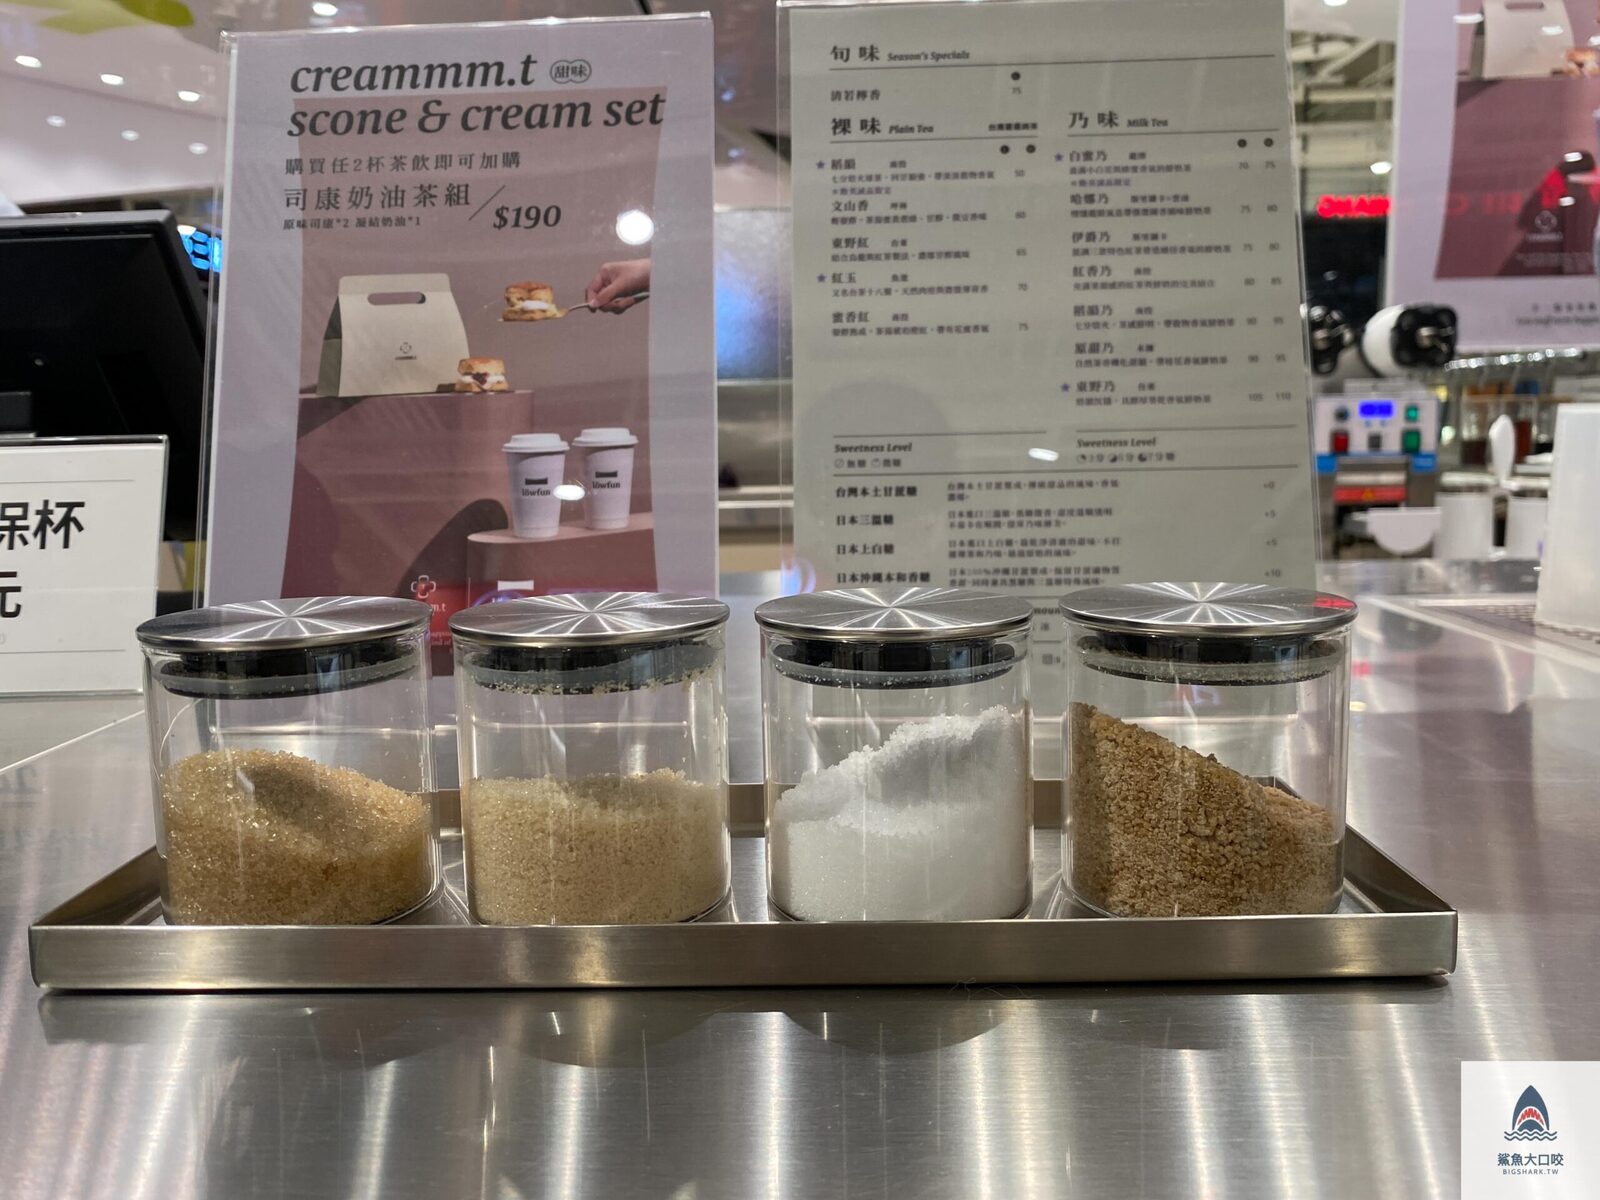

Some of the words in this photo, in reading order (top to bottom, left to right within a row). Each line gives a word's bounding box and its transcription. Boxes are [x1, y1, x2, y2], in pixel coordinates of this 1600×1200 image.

[829, 44, 880, 63] 旬味
[887, 51, 929, 62] Season's
[930, 49, 970, 61] Specials
[288, 52, 539, 94] creammm.t
[553, 63, 589, 80] 甜味
[286, 104, 409, 138] scone
[417, 99, 451, 133] &
[459, 99, 593, 132] cream
[601, 92, 668, 127] set
[1067, 110, 1119, 129] 乃味
[1127, 118, 1149, 128] Milk
[1151, 117, 1169, 127] Tea
[830, 116, 882, 136] 裸味
[888, 124, 915, 134] Plain
[917, 124, 934, 134] Tea
[284, 150, 521, 176] 購買任2杯茶飲即可加購
[283, 181, 472, 212] 司康奶油茶組
[492, 203, 562, 231] $190
[831, 199, 869, 213] 文山香
[834, 444, 886, 454] Sweetness
[887, 442, 913, 453] Level
[1076, 438, 1129, 449] Sweetness
[1130, 436, 1157, 447] Level
[836, 514, 895, 526] 日本三溫糖
[836, 544, 895, 555] 日本上白糖
